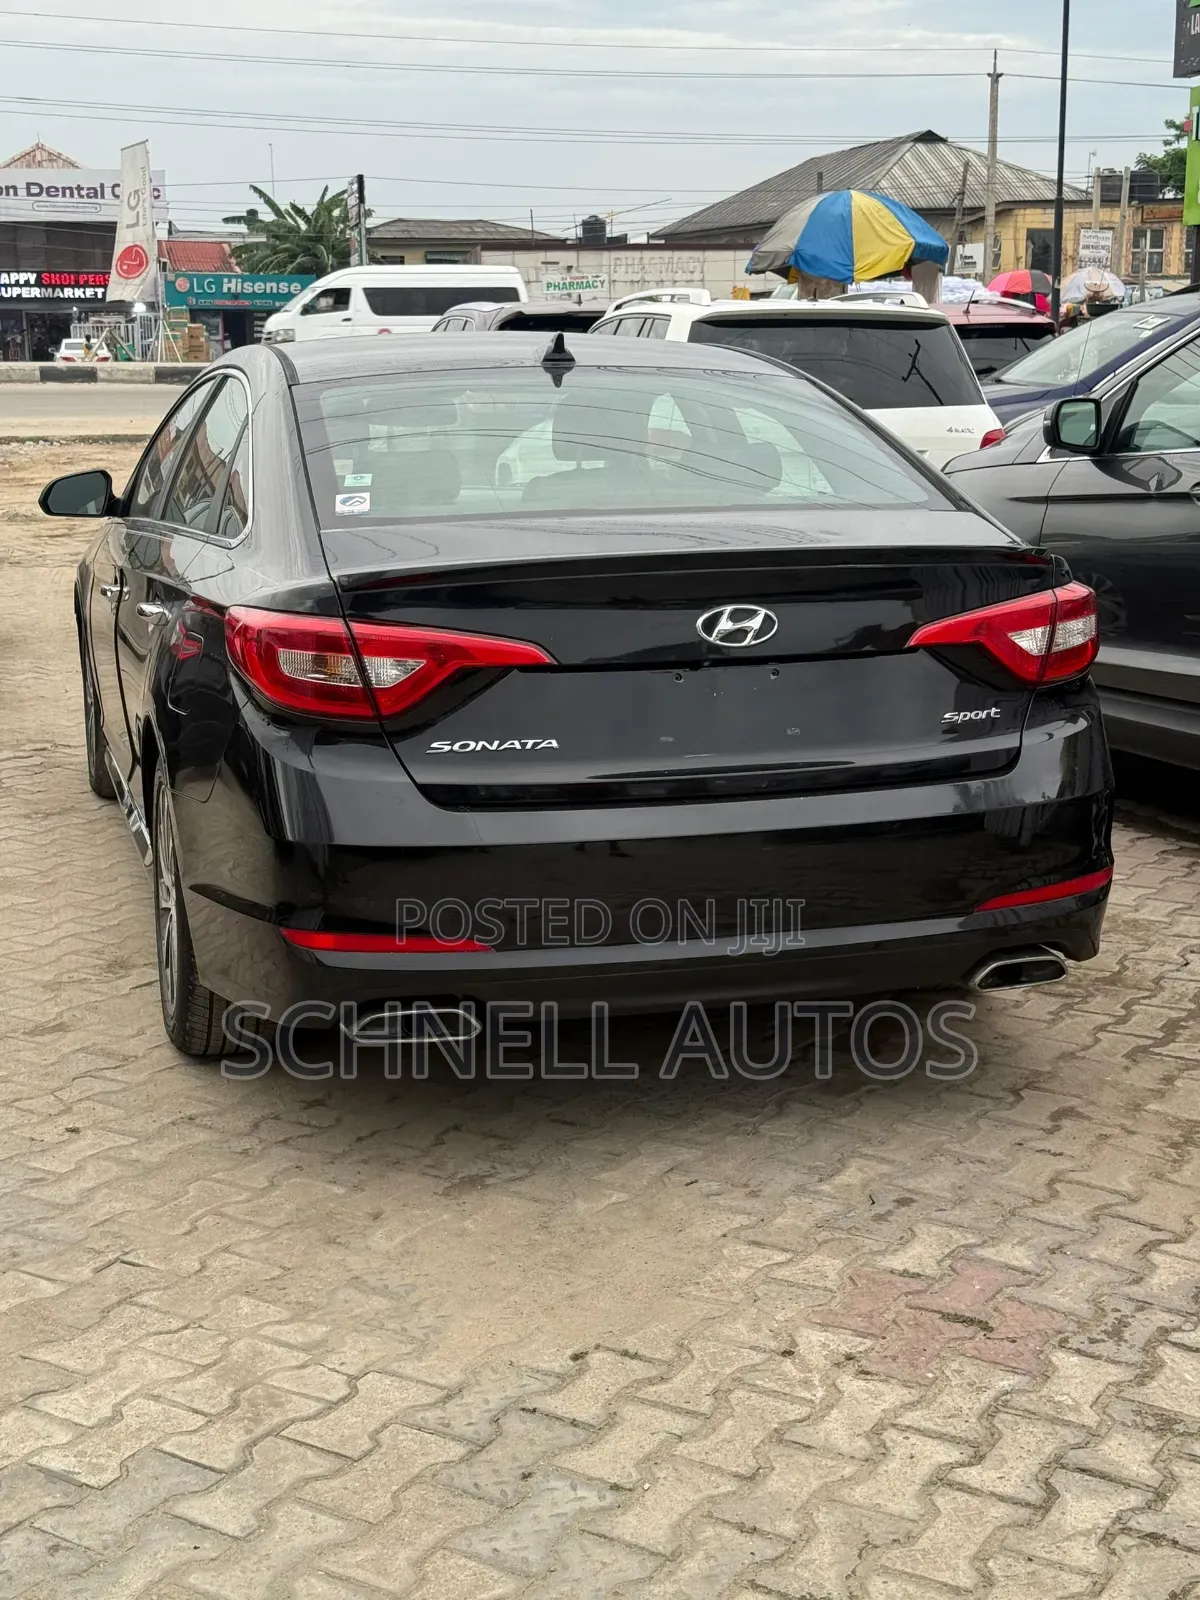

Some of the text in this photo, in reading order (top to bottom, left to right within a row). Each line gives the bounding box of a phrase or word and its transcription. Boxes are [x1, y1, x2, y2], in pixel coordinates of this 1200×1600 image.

[140, 166, 148, 195] Good
[26, 182, 105, 199] Dental
[125, 188, 140, 229] LG
[0, 286, 105, 299] UPERMARKET
[193, 277, 302, 294] LG Hisense
[546, 279, 606, 292] PHARMACY
[940, 707, 1001, 724] Sport
[425, 739, 560, 754] SONATA
